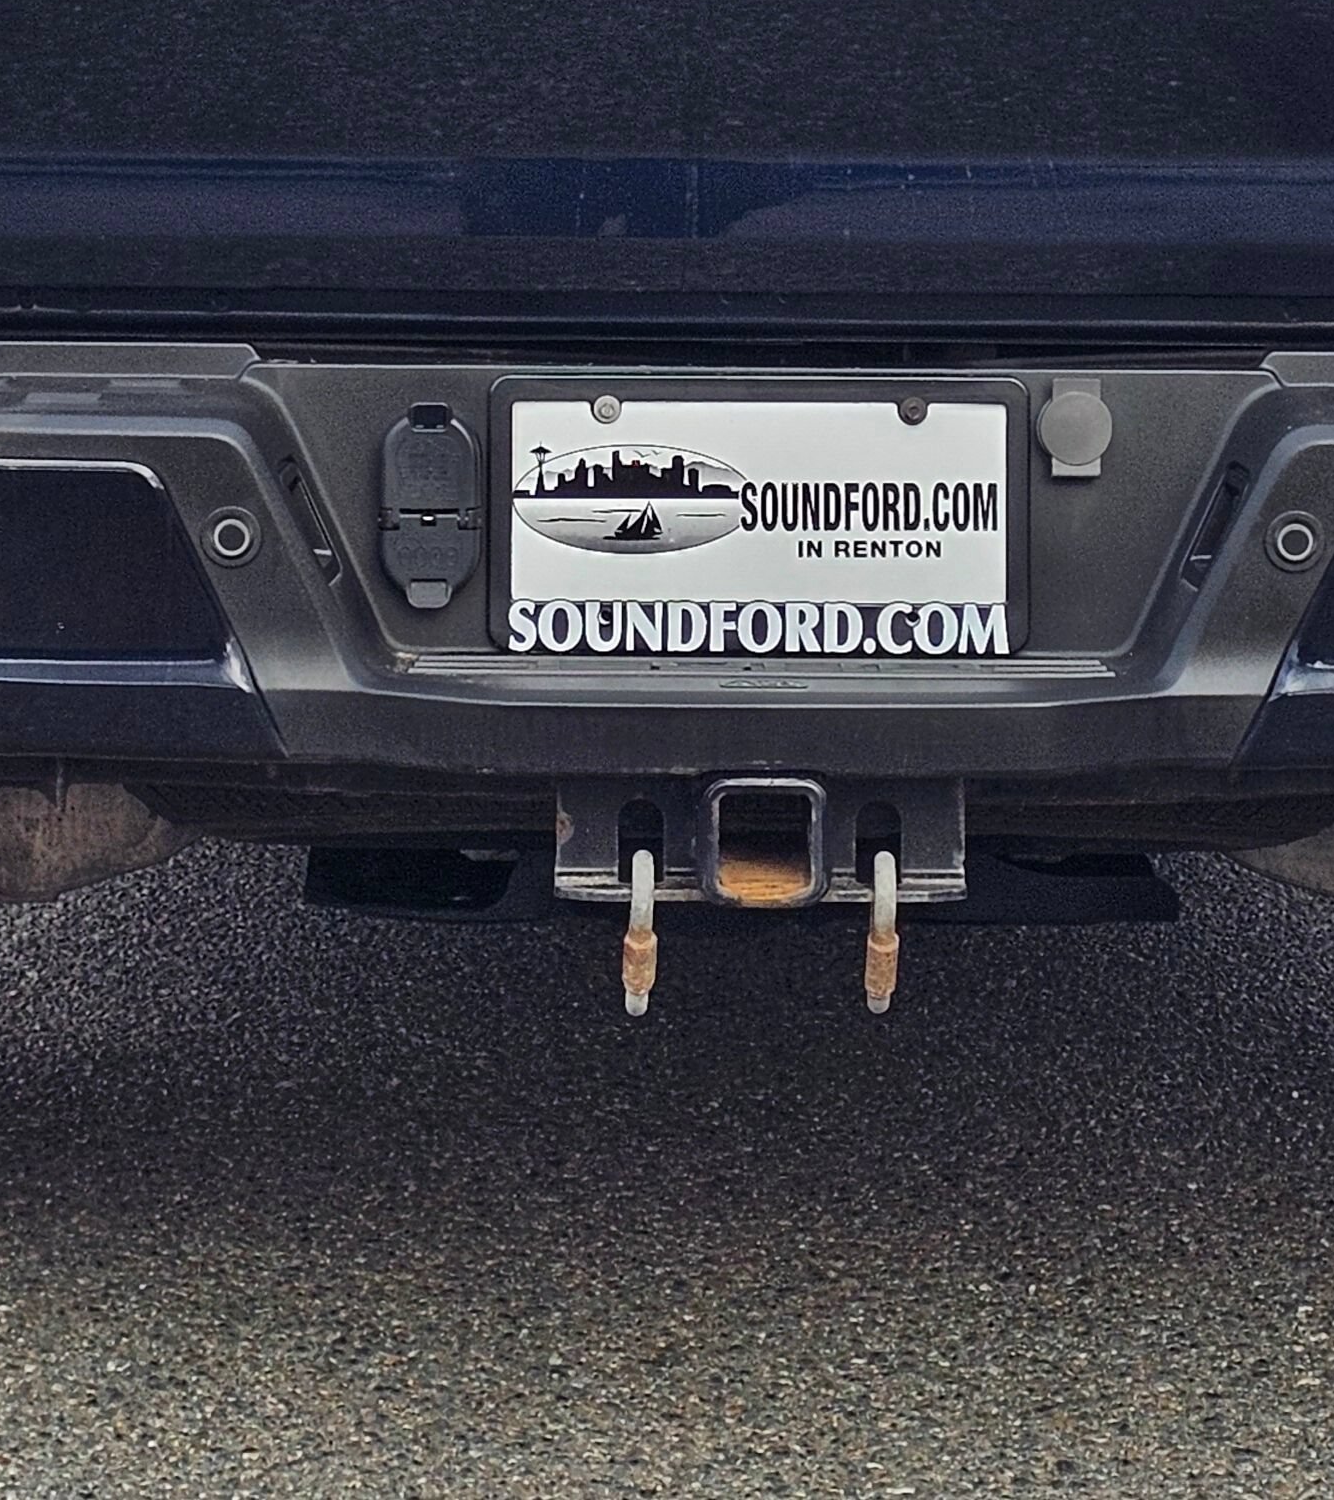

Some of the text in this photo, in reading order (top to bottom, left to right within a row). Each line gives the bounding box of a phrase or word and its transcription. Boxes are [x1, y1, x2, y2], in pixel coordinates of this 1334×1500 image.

[740, 481, 998, 531] SOUNDFORD.COM
[798, 540, 942, 558] IN RENTON
[508, 599, 1011, 655] SOUNDFORD.COM
